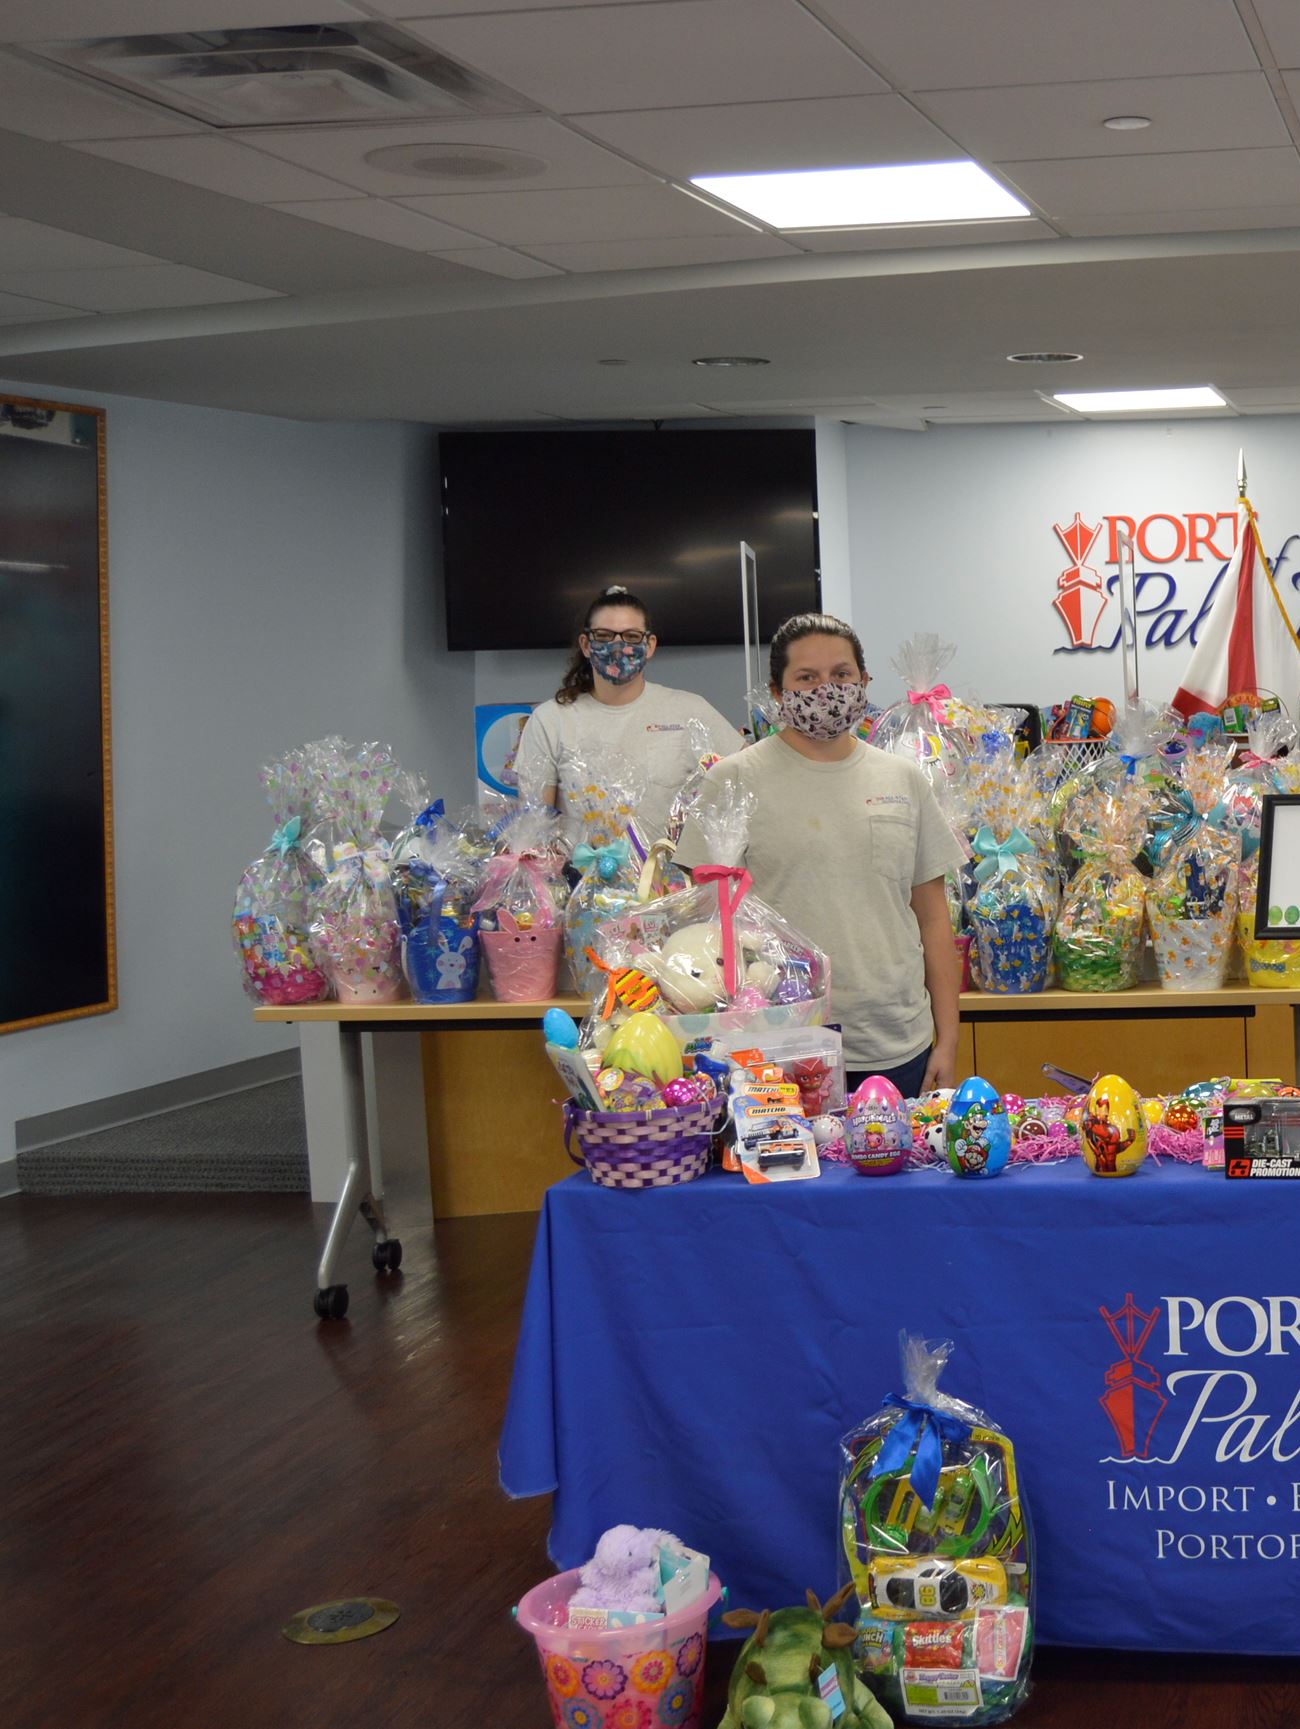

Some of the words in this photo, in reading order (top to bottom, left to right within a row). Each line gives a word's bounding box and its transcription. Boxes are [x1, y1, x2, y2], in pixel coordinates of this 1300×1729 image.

[1251, 1158, 1293, 1169] DIE-CAST
[1106, 1479, 1256, 1513] IMPORT
[571, 1616, 605, 1626] STICKER
[911, 1632, 952, 1647] Skittles
